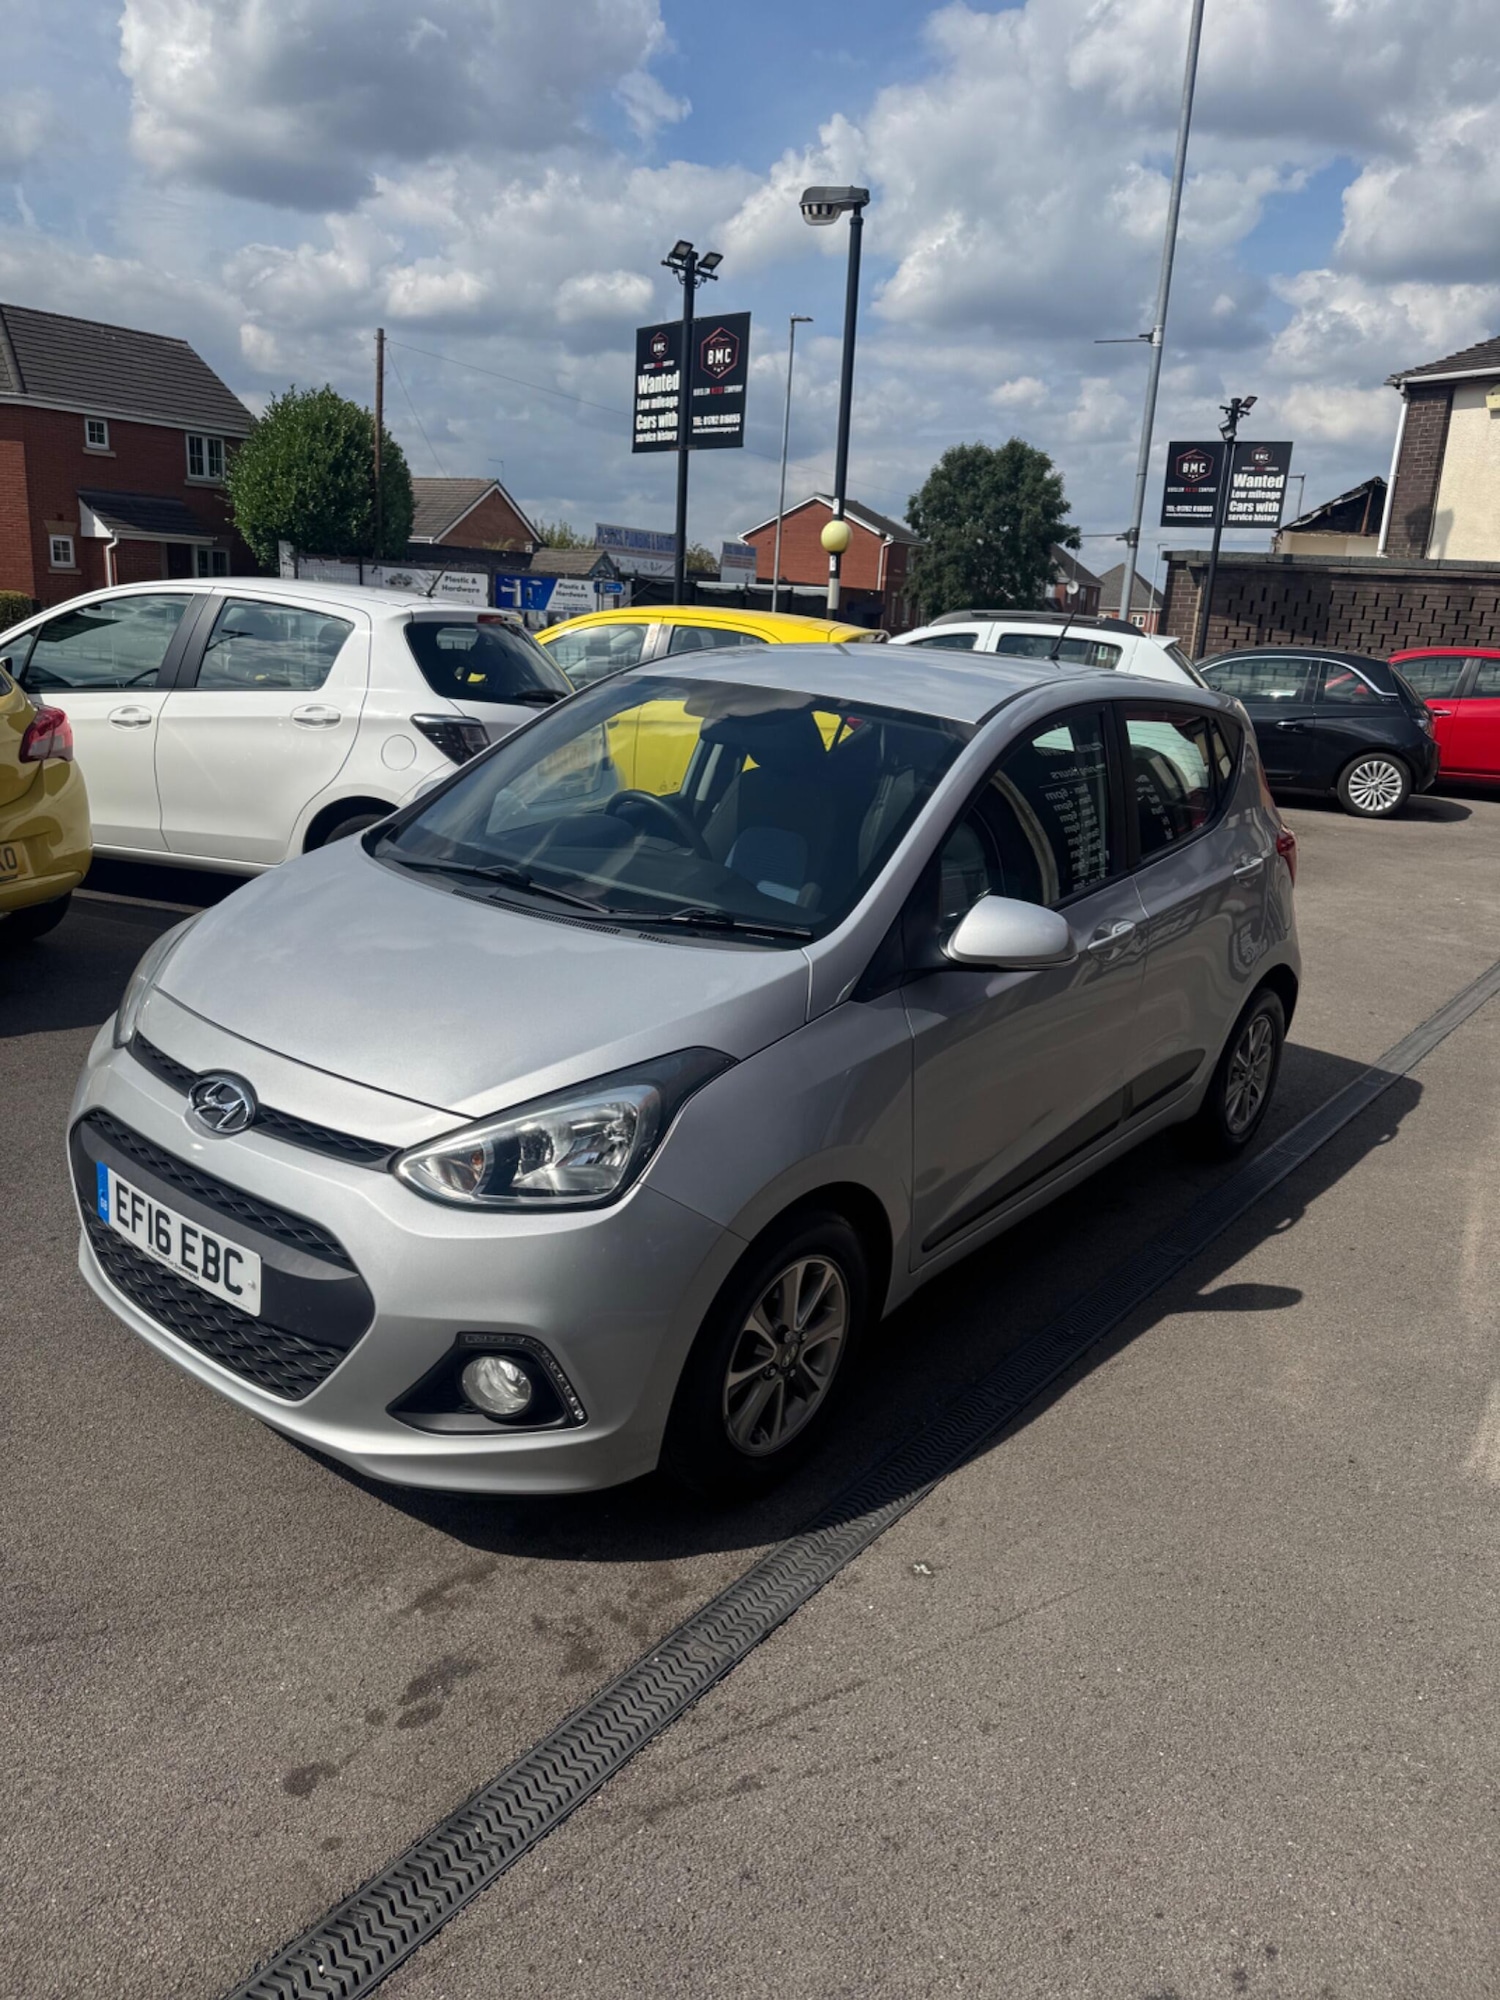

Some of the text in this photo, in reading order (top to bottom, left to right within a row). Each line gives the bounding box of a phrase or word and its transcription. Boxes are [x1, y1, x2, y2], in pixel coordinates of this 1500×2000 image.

[653, 342, 665, 352] BMC
[707, 348, 732, 365] BMC
[638, 370, 680, 395] Wanted
[637, 395, 679, 411] Low mileage
[636, 412, 679, 430] Cars with
[635, 430, 678, 443] service history
[1182, 462, 1206, 474] BMC
[1233, 473, 1285, 489] Wanted
[1231, 490, 1281, 500] Low mileage
[1229, 501, 1280, 512] Cars with
[1253, 514, 1278, 523] history
[444, 575, 469, 584] Plastic
[442, 584, 480, 593] Hardware
[558, 582, 579, 590] Plastic
[556, 590, 588, 598] Hardware
[116, 1180, 244, 1296] EF16 EBC
